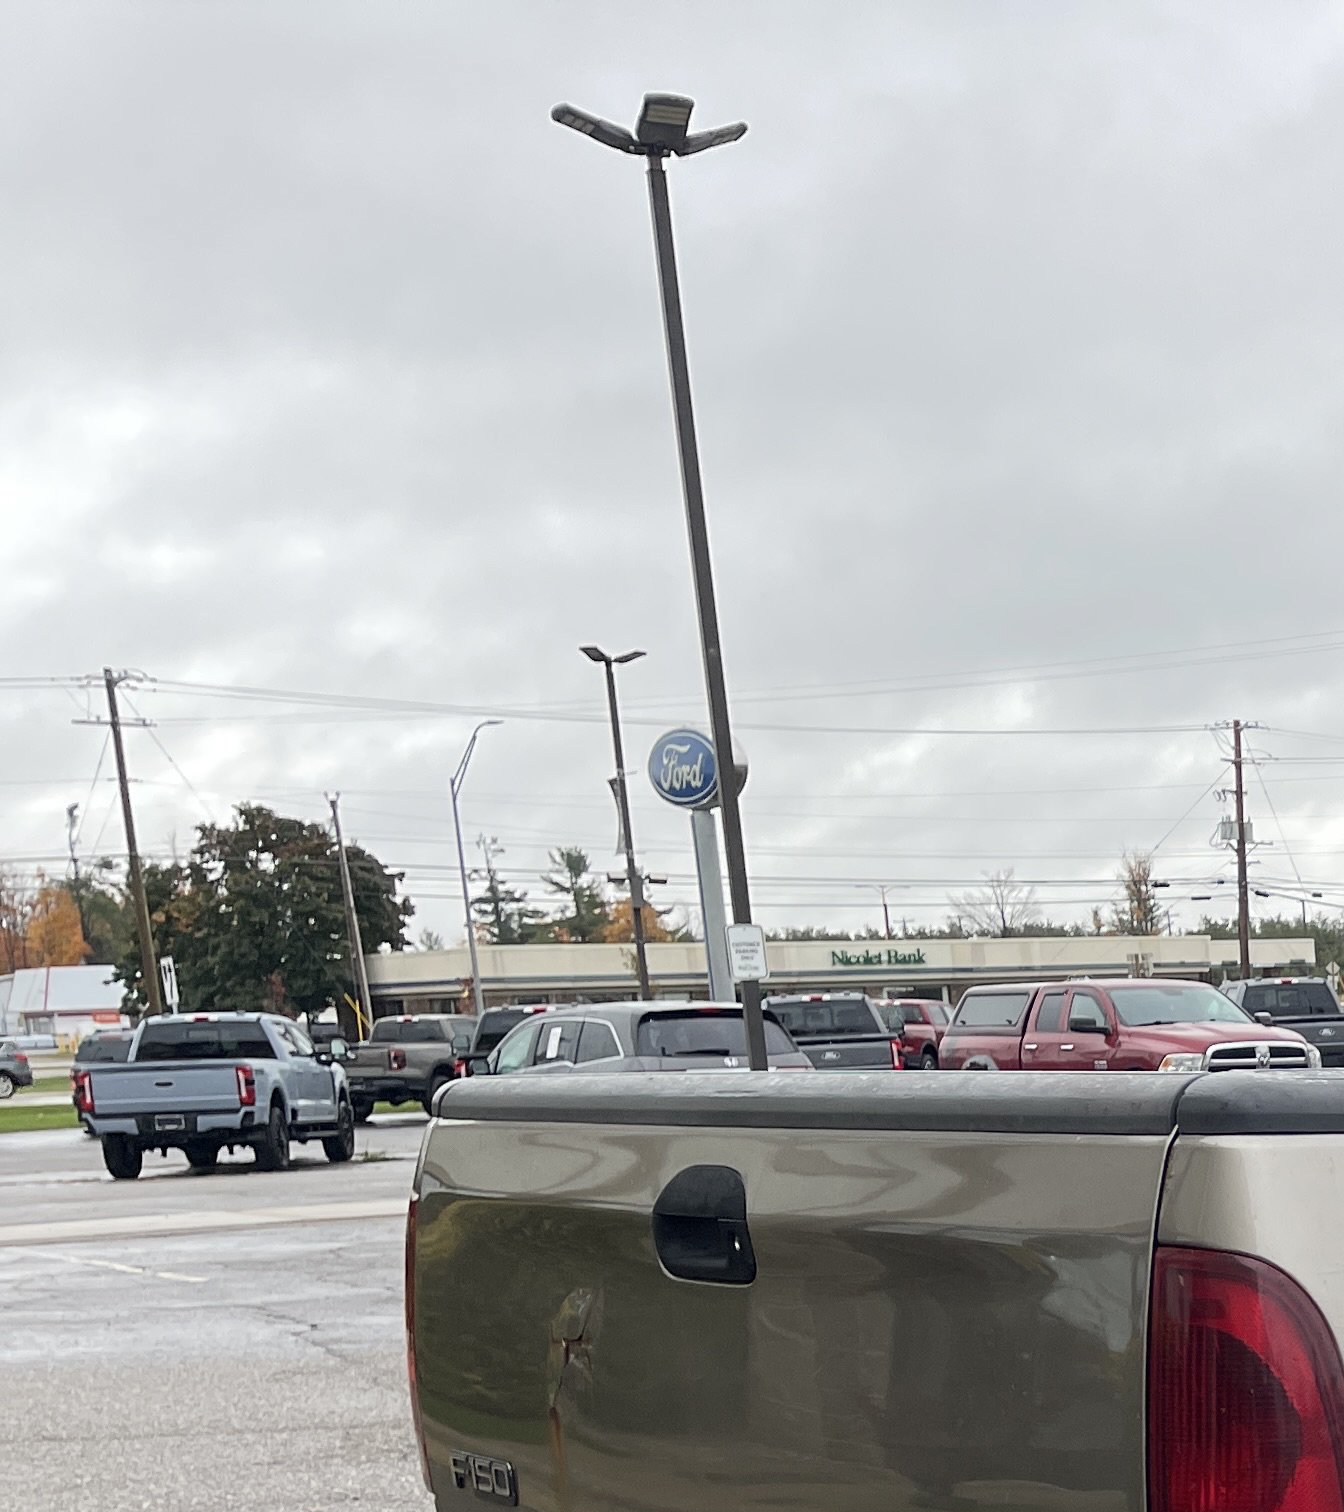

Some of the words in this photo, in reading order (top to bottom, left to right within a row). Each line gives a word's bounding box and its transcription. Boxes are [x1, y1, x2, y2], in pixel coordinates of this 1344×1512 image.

[660, 743, 704, 792] Ford
[831, 949, 882, 967] Nicolet
[887, 948, 926, 965] Bank
